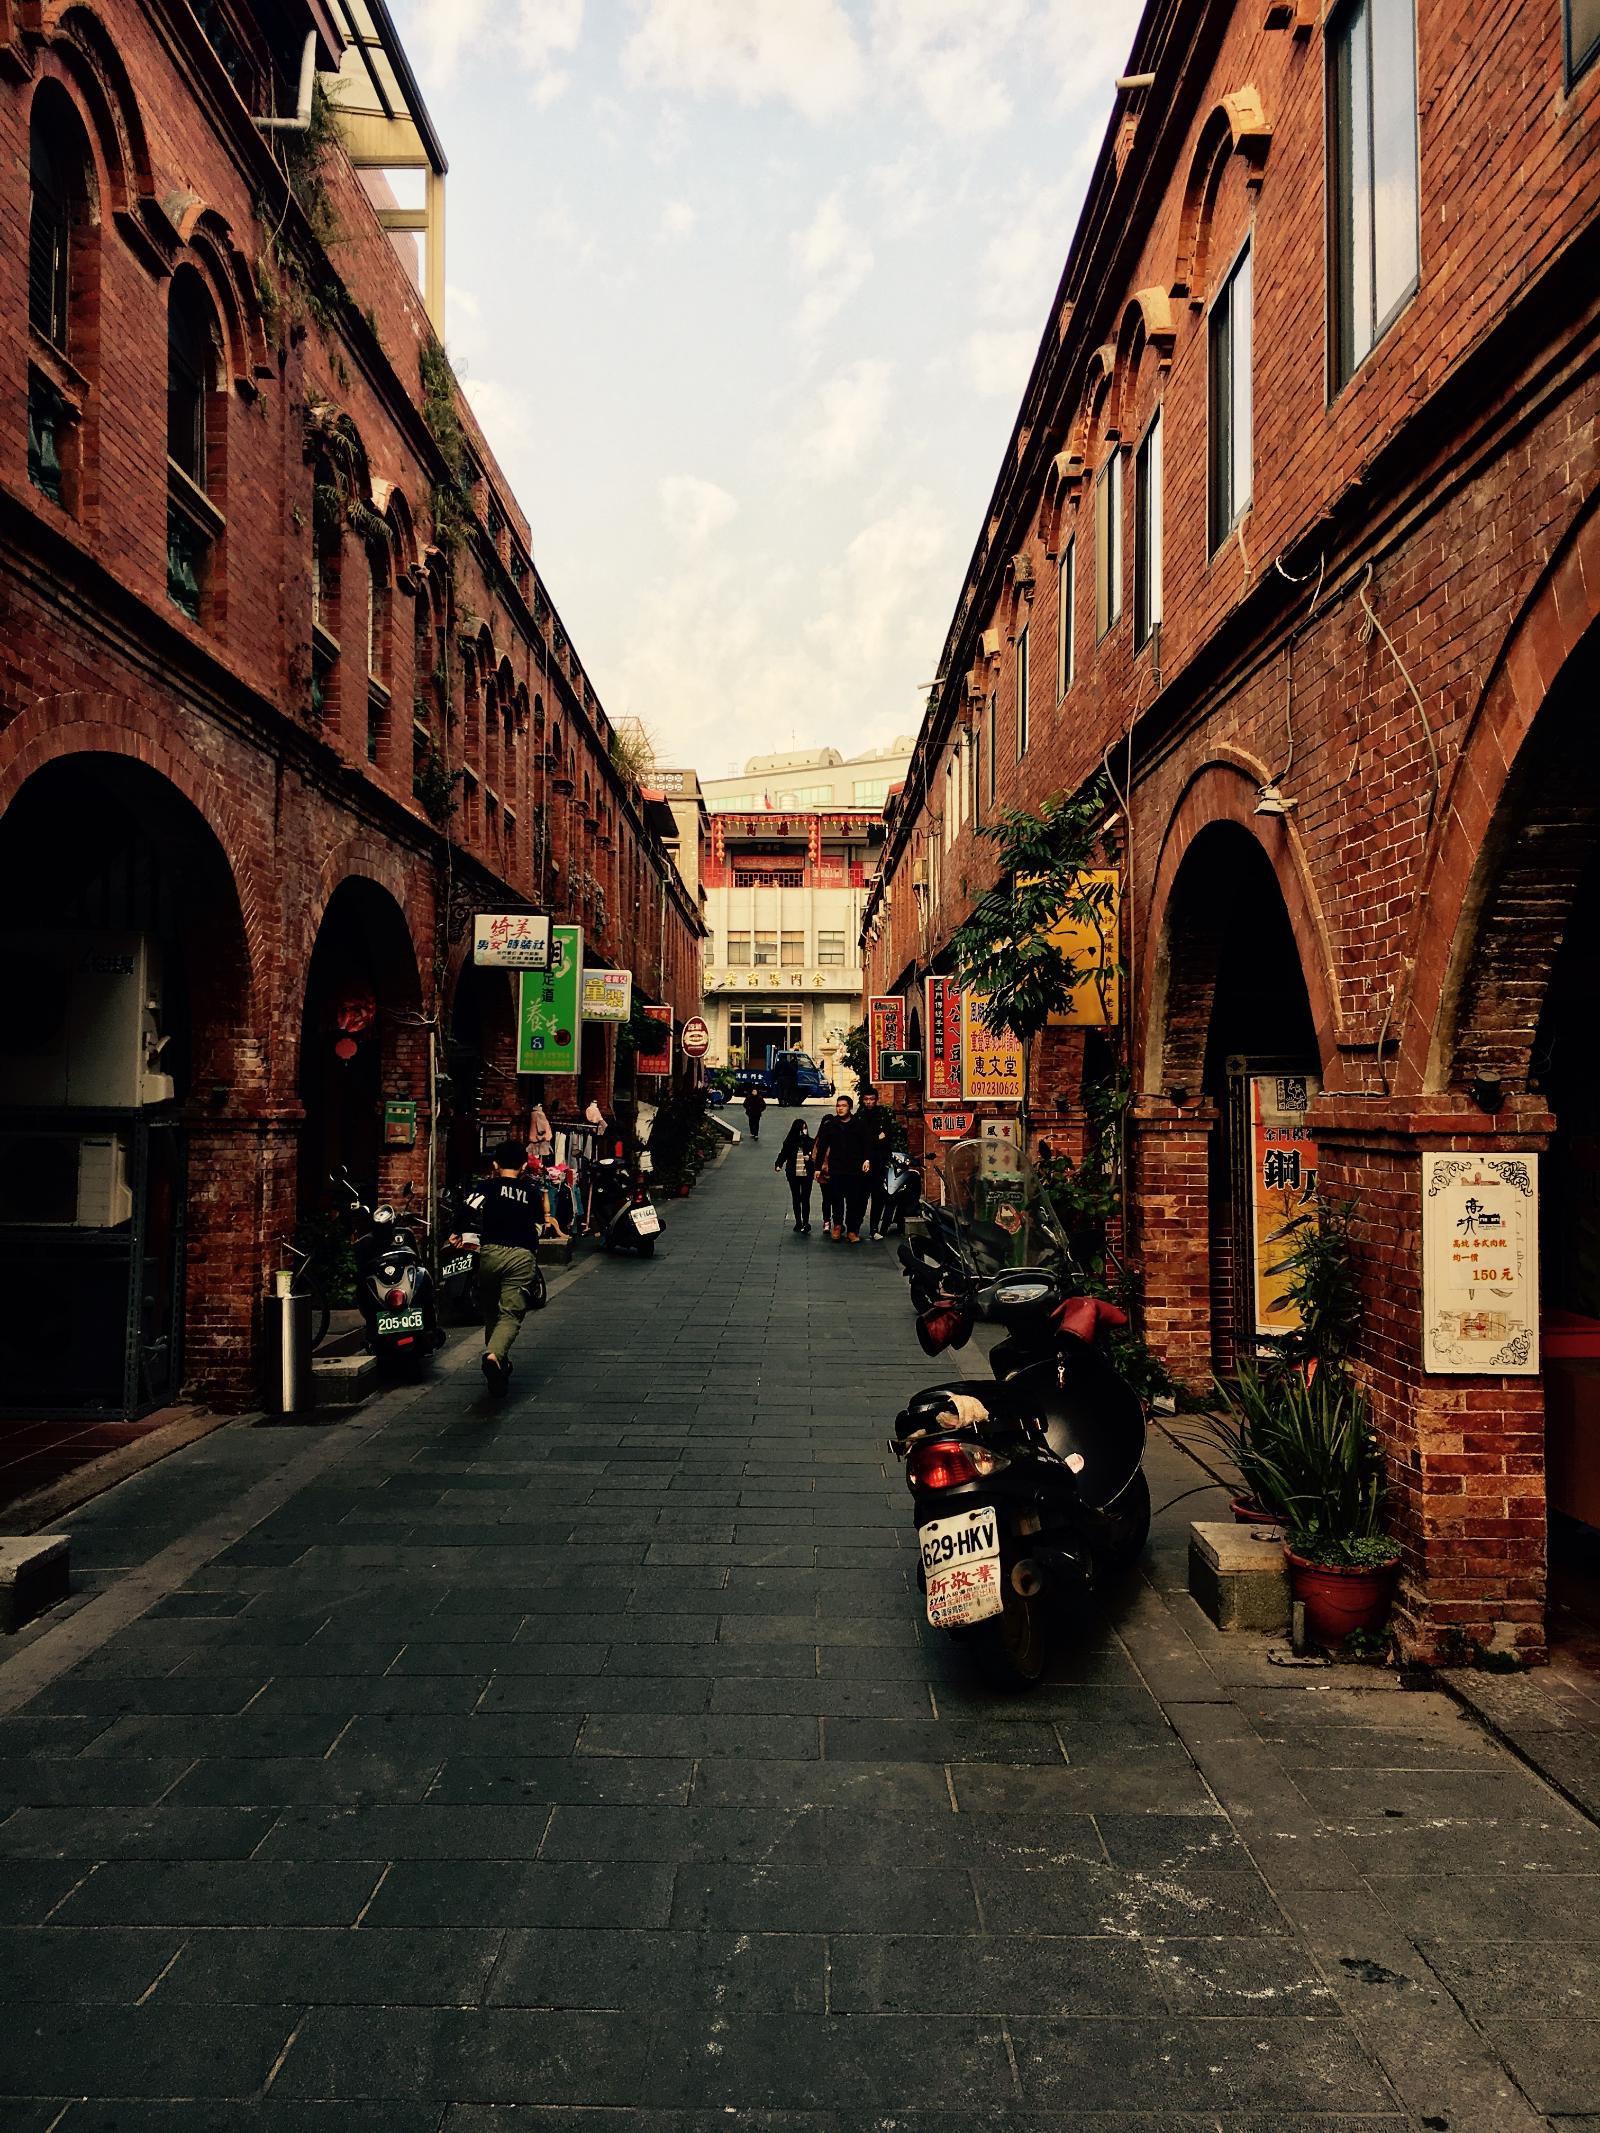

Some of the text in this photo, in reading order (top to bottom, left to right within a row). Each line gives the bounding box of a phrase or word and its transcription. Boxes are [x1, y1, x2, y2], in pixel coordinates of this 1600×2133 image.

[477, 940, 545, 950] 男女時裝社
[973, 1056, 1018, 1077] 惠文堂
[971, 1081, 1020, 1096] 0972310625
[932, 1116, 967, 1131] 燒仙草
[1472, 1267, 1514, 1281] 150 元
[922, 1522, 995, 1569] 629-HKV
